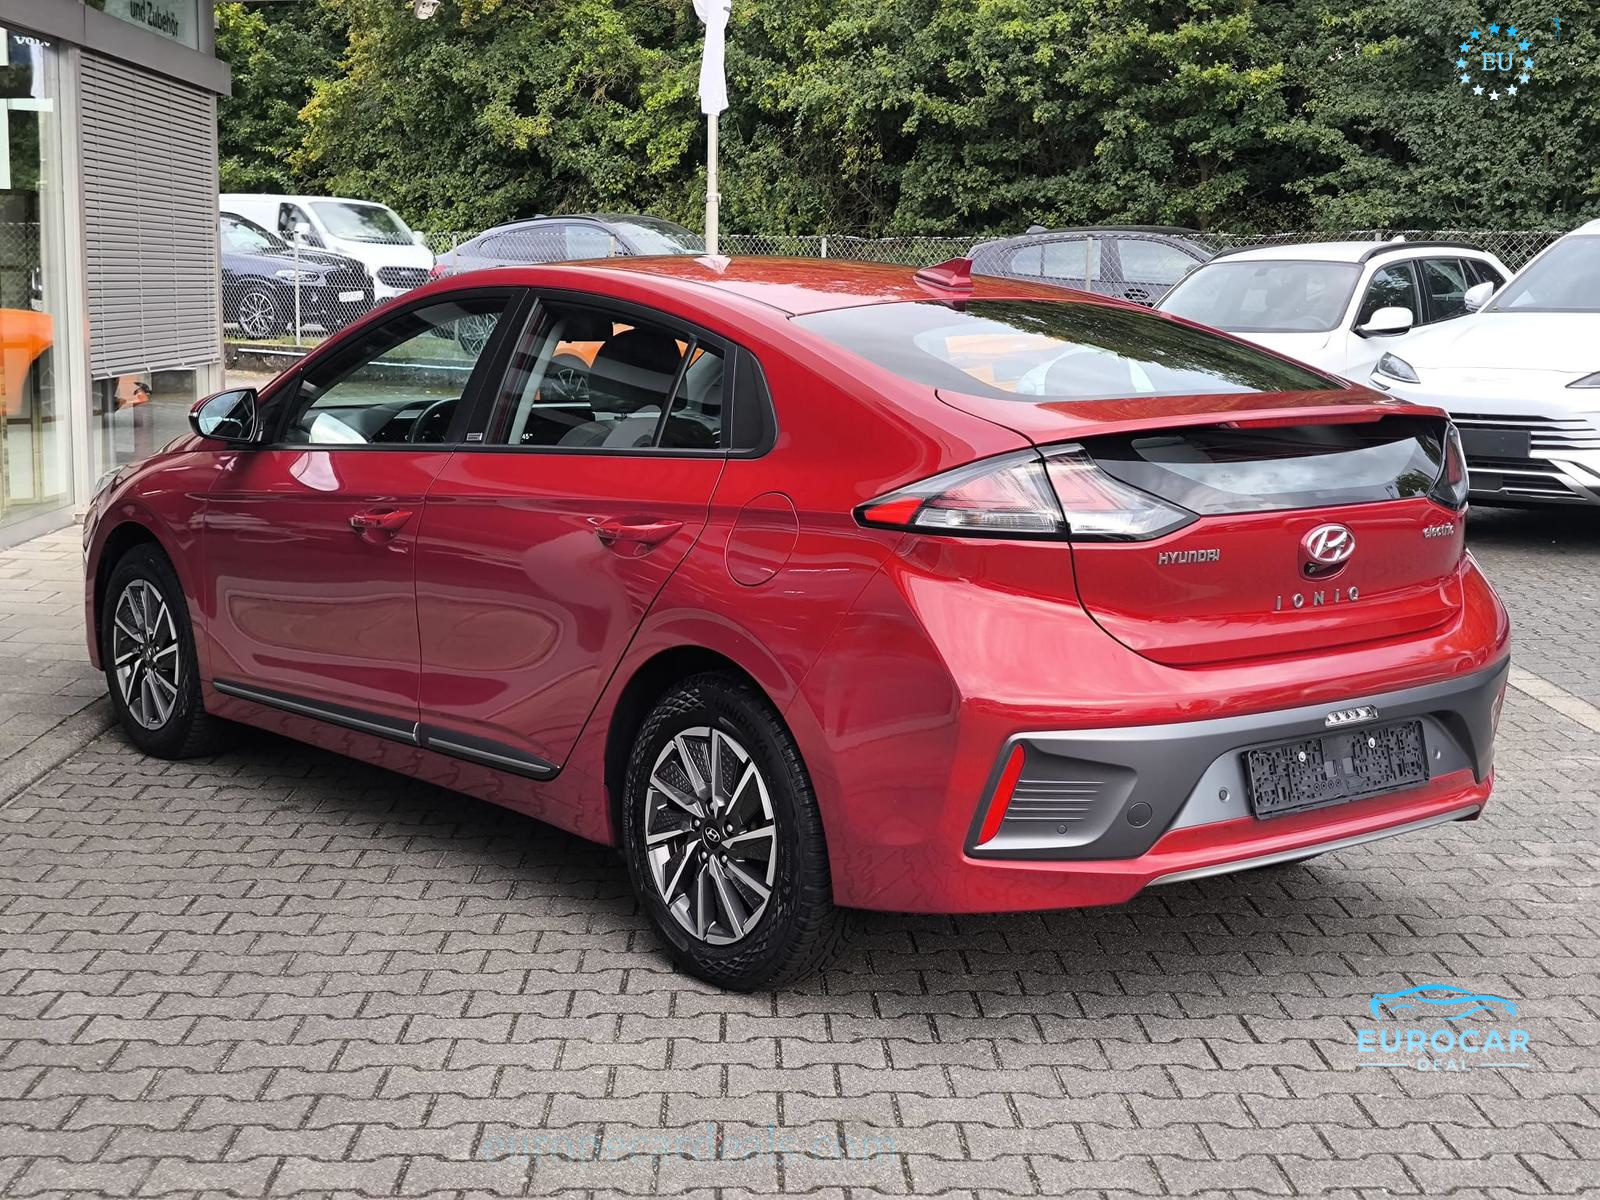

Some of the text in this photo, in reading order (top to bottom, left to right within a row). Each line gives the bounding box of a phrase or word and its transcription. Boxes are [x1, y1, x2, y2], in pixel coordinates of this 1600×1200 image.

[129, 0, 179, 37] und Zubehör
[1158, 549, 1220, 565] HYUNDAI
[1276, 586, 1360, 611] IONIQ
